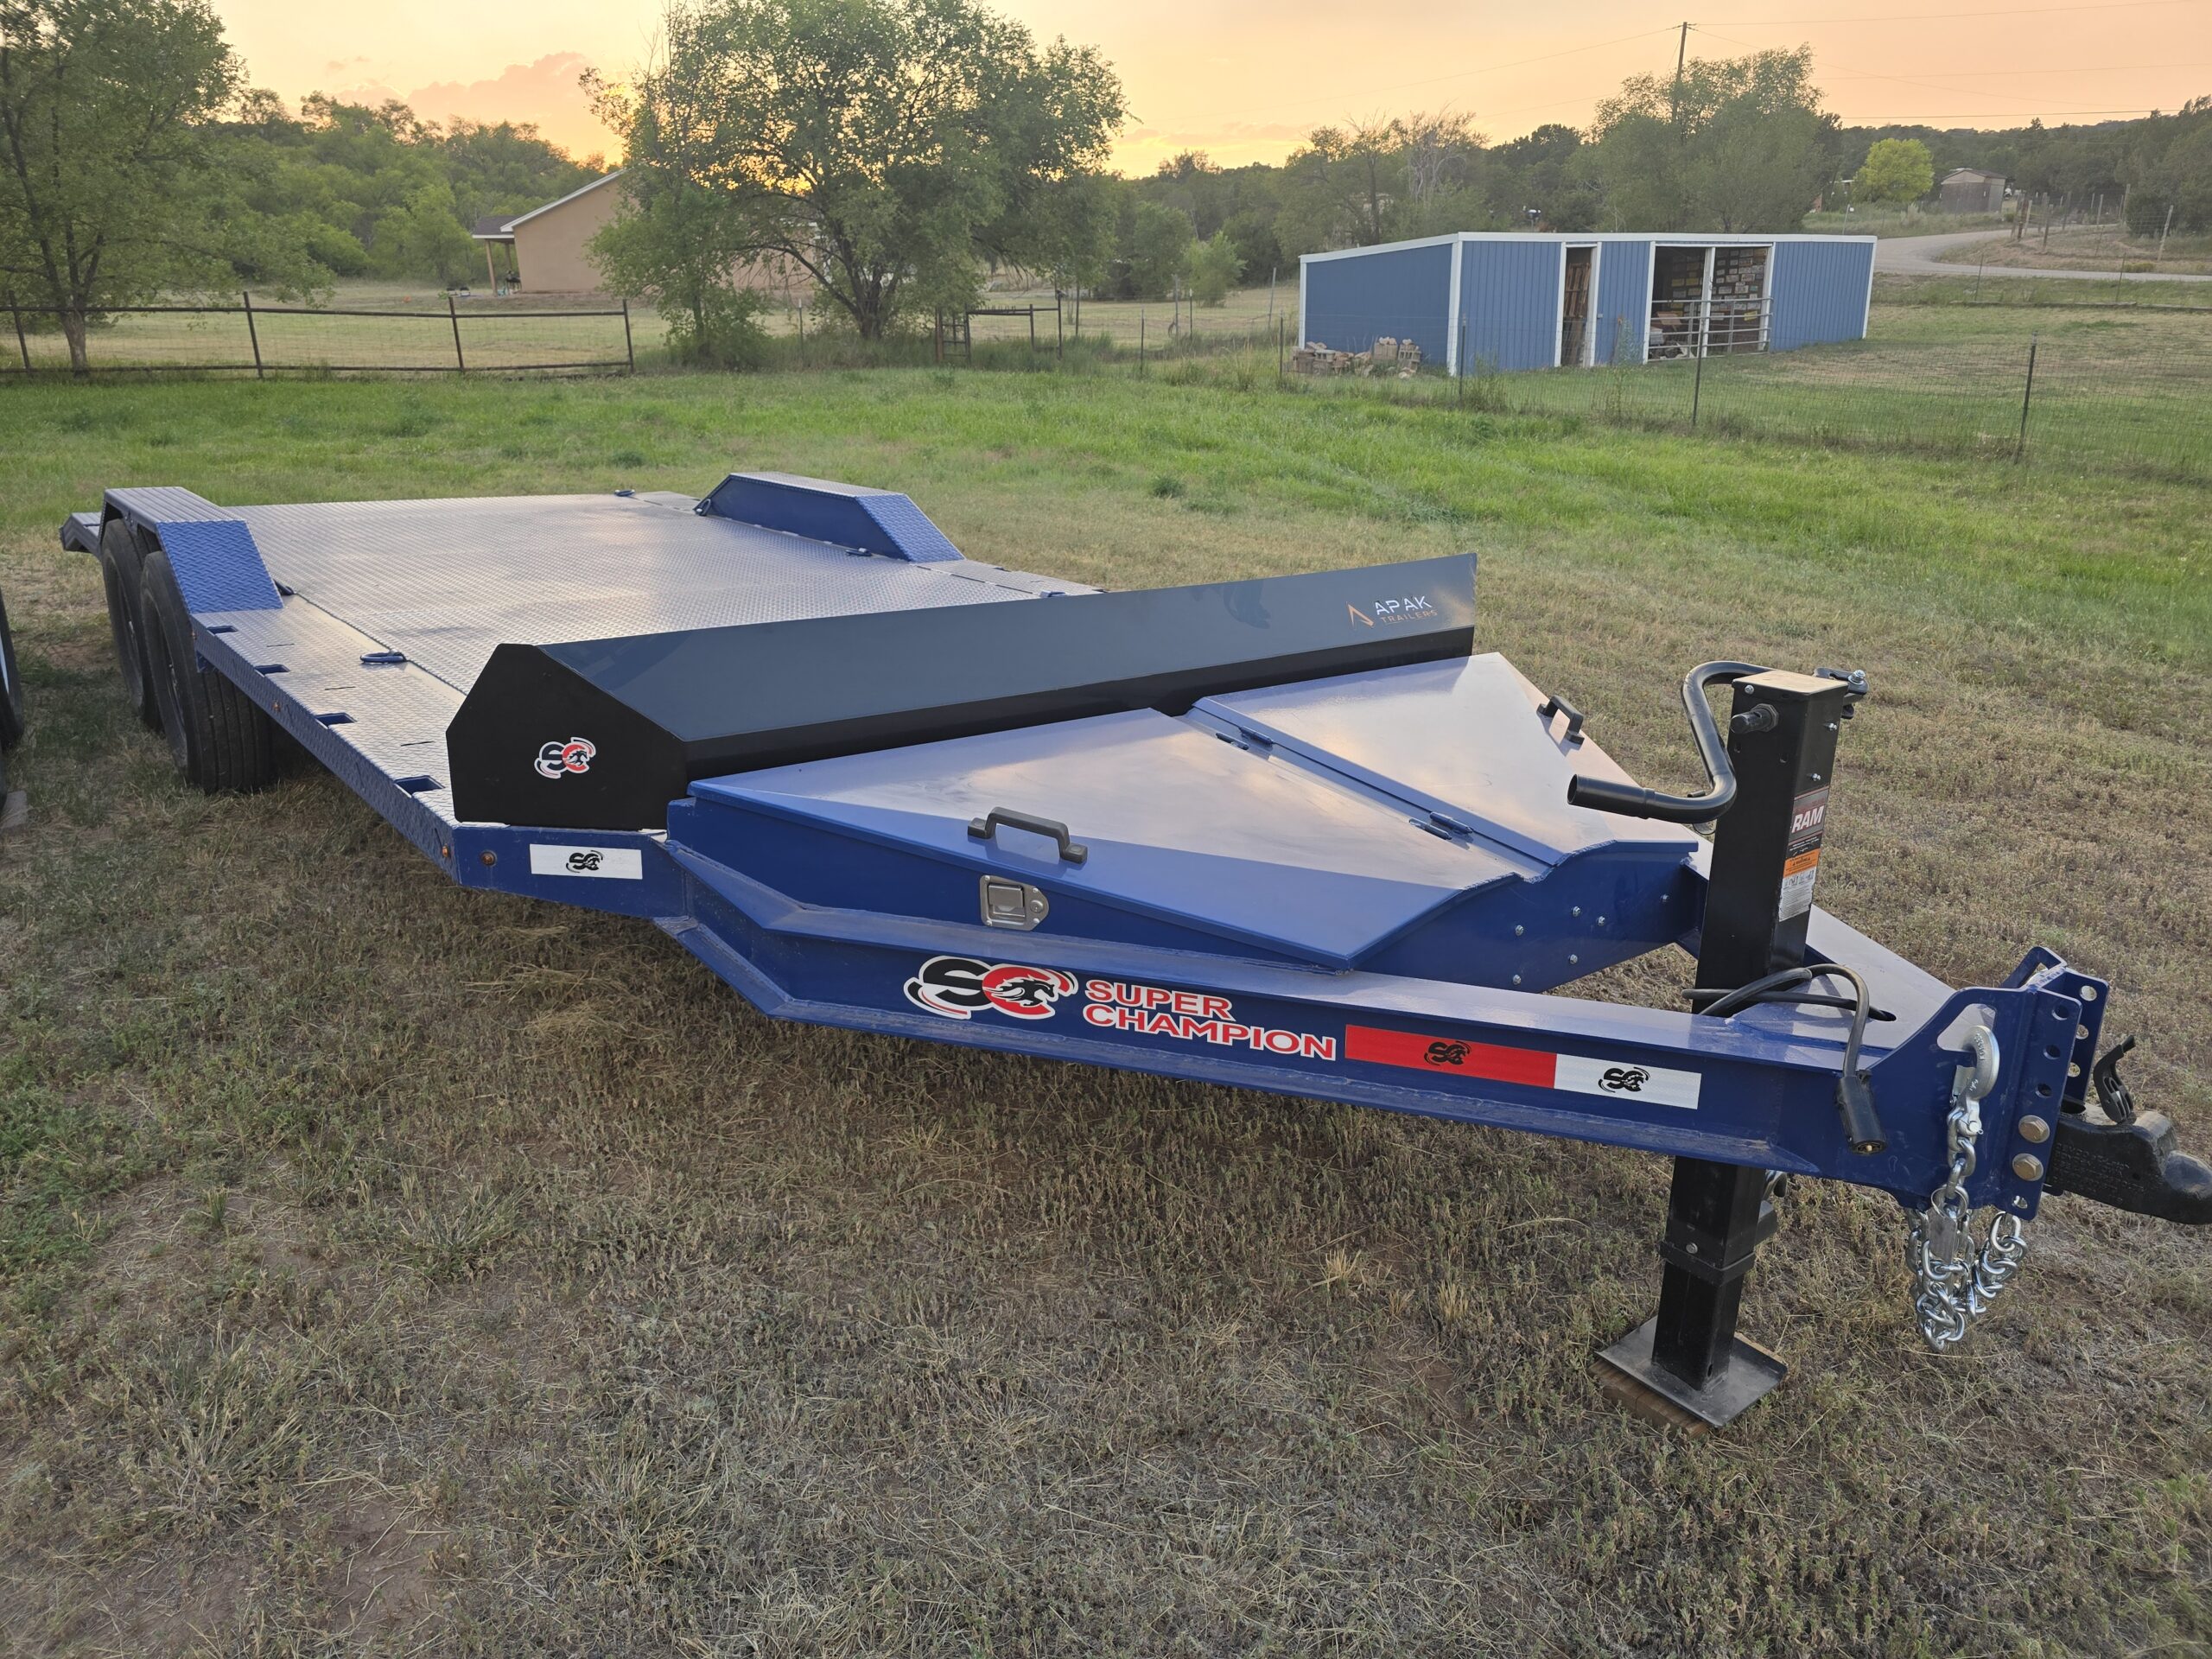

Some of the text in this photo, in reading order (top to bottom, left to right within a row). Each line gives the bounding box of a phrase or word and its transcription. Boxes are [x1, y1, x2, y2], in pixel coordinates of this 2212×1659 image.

[1375, 595, 1433, 615] APAK
[1380, 610, 1439, 623] TRAILERS
[1791, 805, 1825, 833] RAM
[1085, 979, 1234, 1020] SUPER
[1084, 1004, 1336, 1061] CHAMPION
